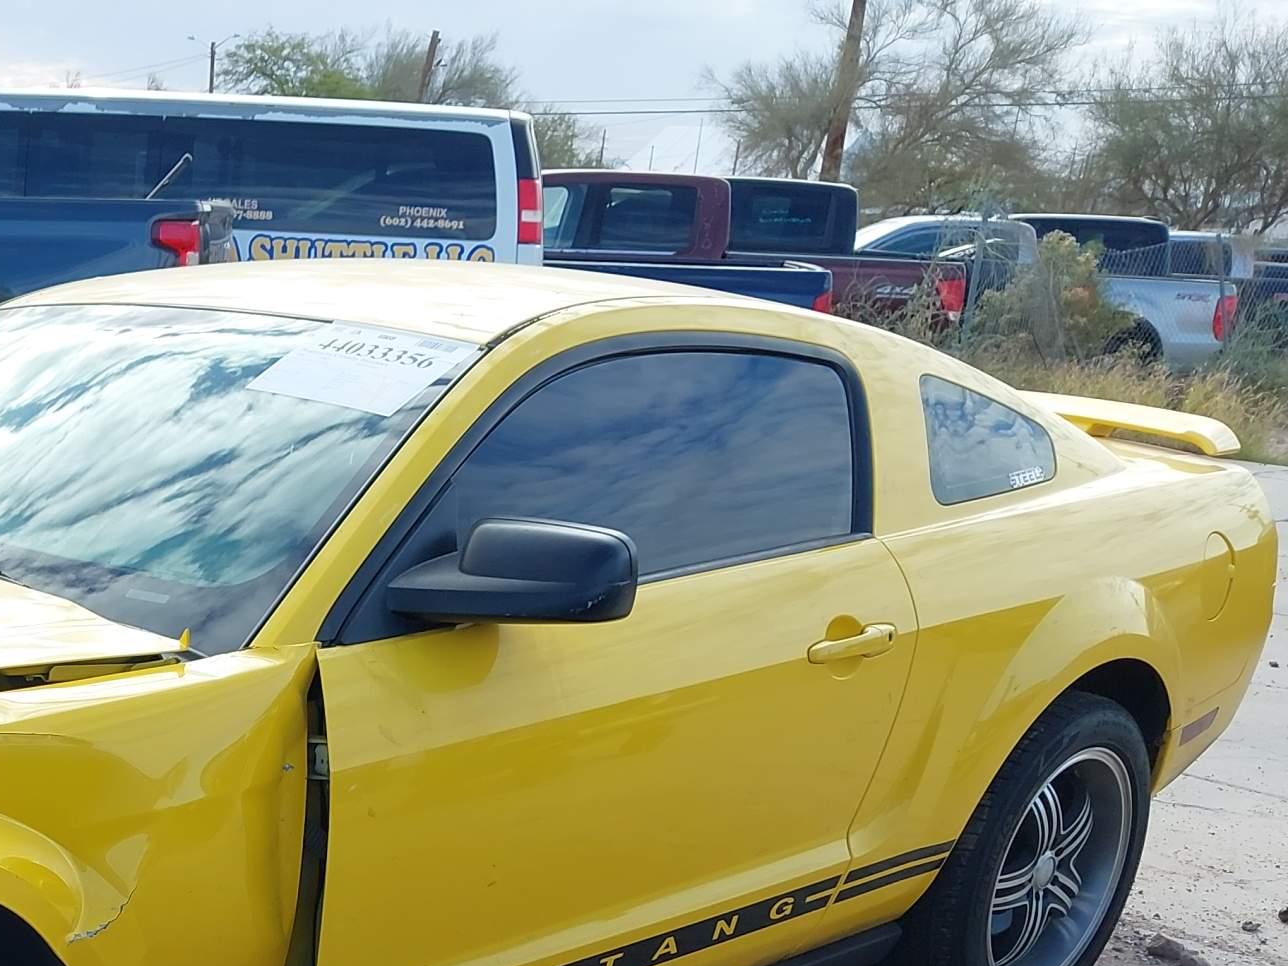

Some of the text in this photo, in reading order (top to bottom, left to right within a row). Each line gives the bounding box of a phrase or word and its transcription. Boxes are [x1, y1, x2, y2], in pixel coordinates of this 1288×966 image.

[399, 206, 448, 218] PHOENIX
[380, 215, 412, 229] (602)
[319, 338, 435, 368] 44033356
